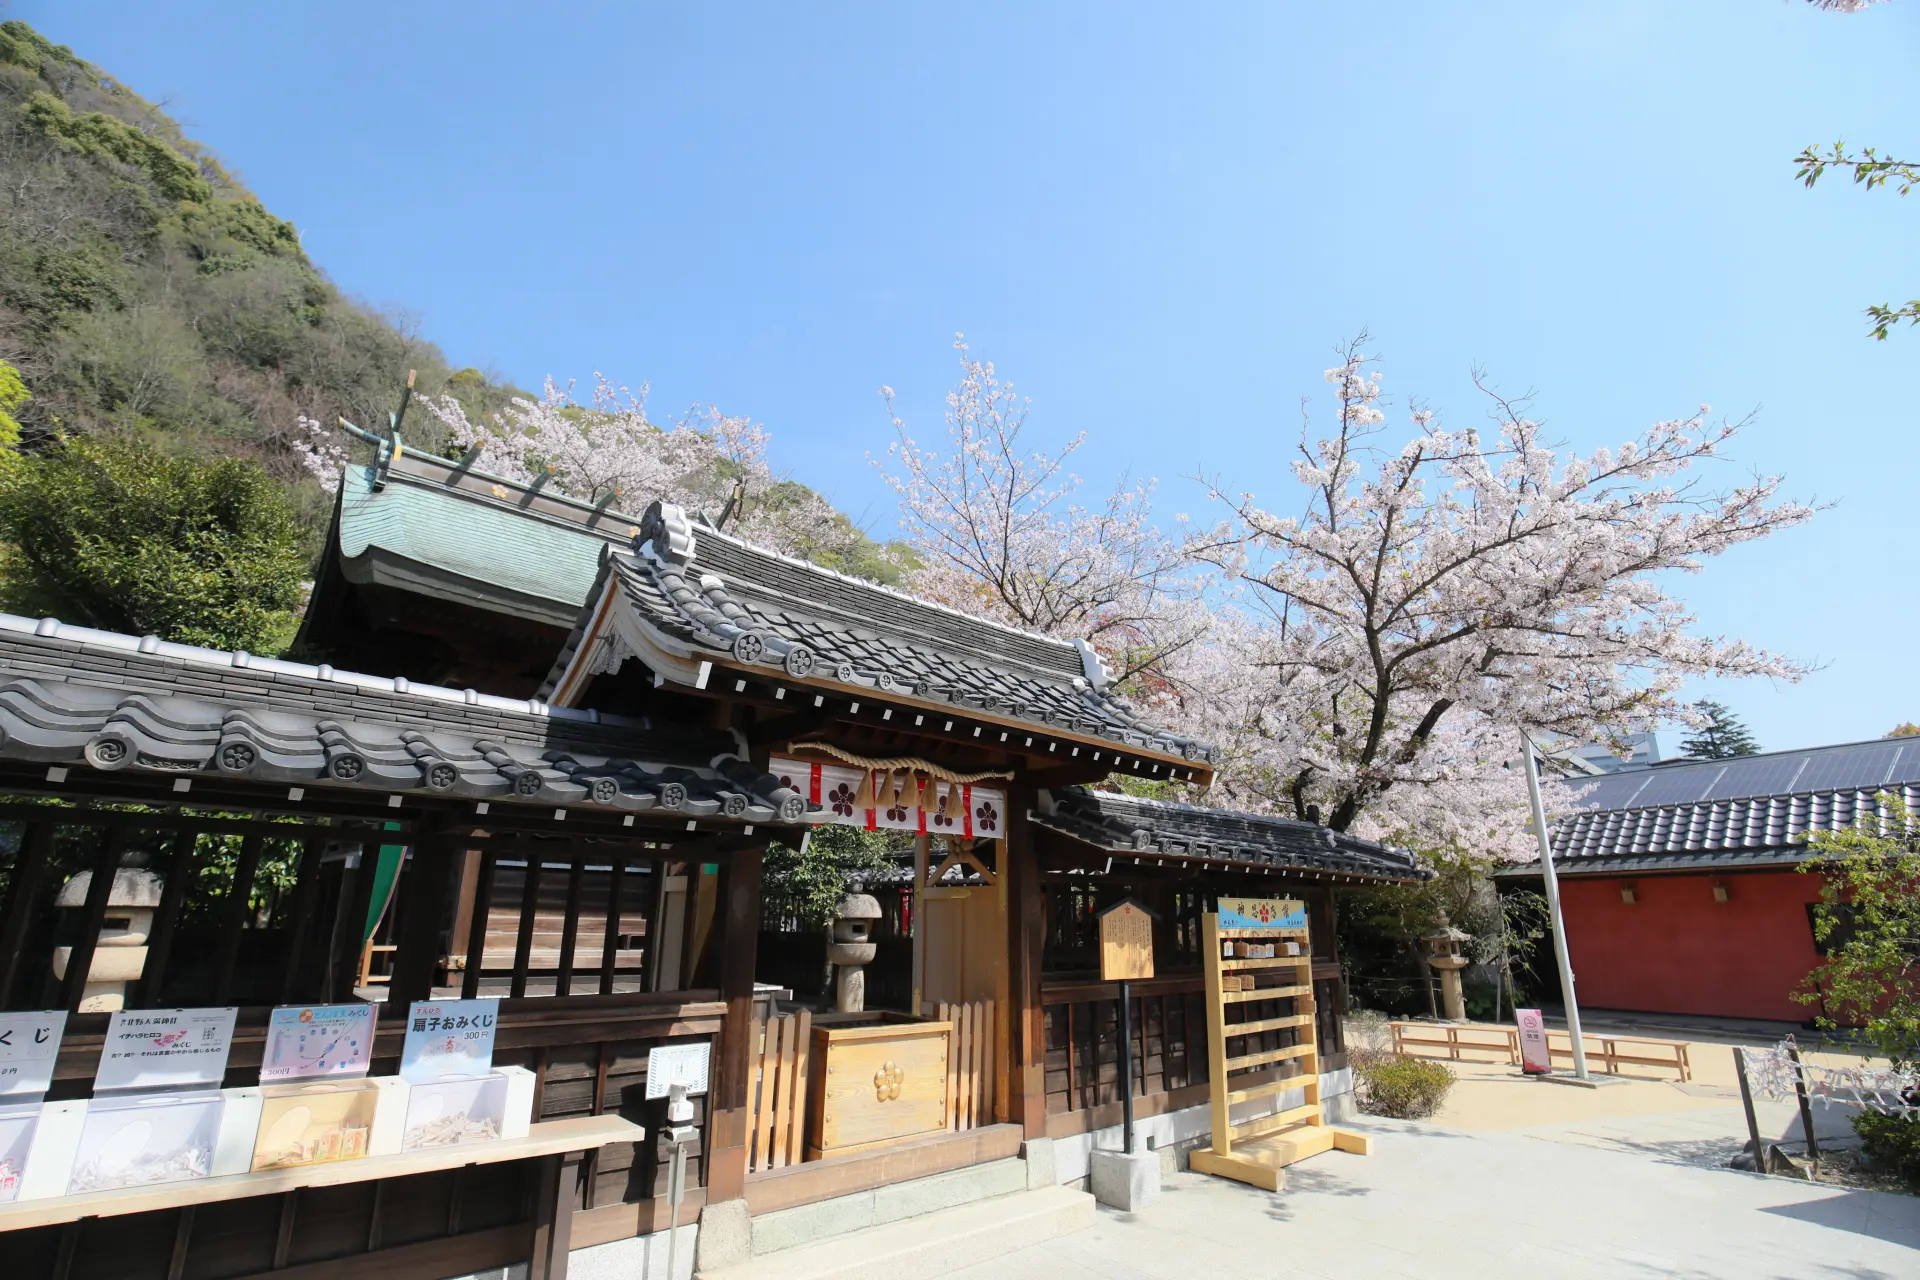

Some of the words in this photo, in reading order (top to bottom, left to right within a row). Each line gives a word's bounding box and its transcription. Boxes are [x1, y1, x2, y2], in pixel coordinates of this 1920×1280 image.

[412, 1014, 493, 1032] 扇子おみくじ
[464, 1031, 488, 1040] 300円
[267, 1067, 290, 1076] 300円
